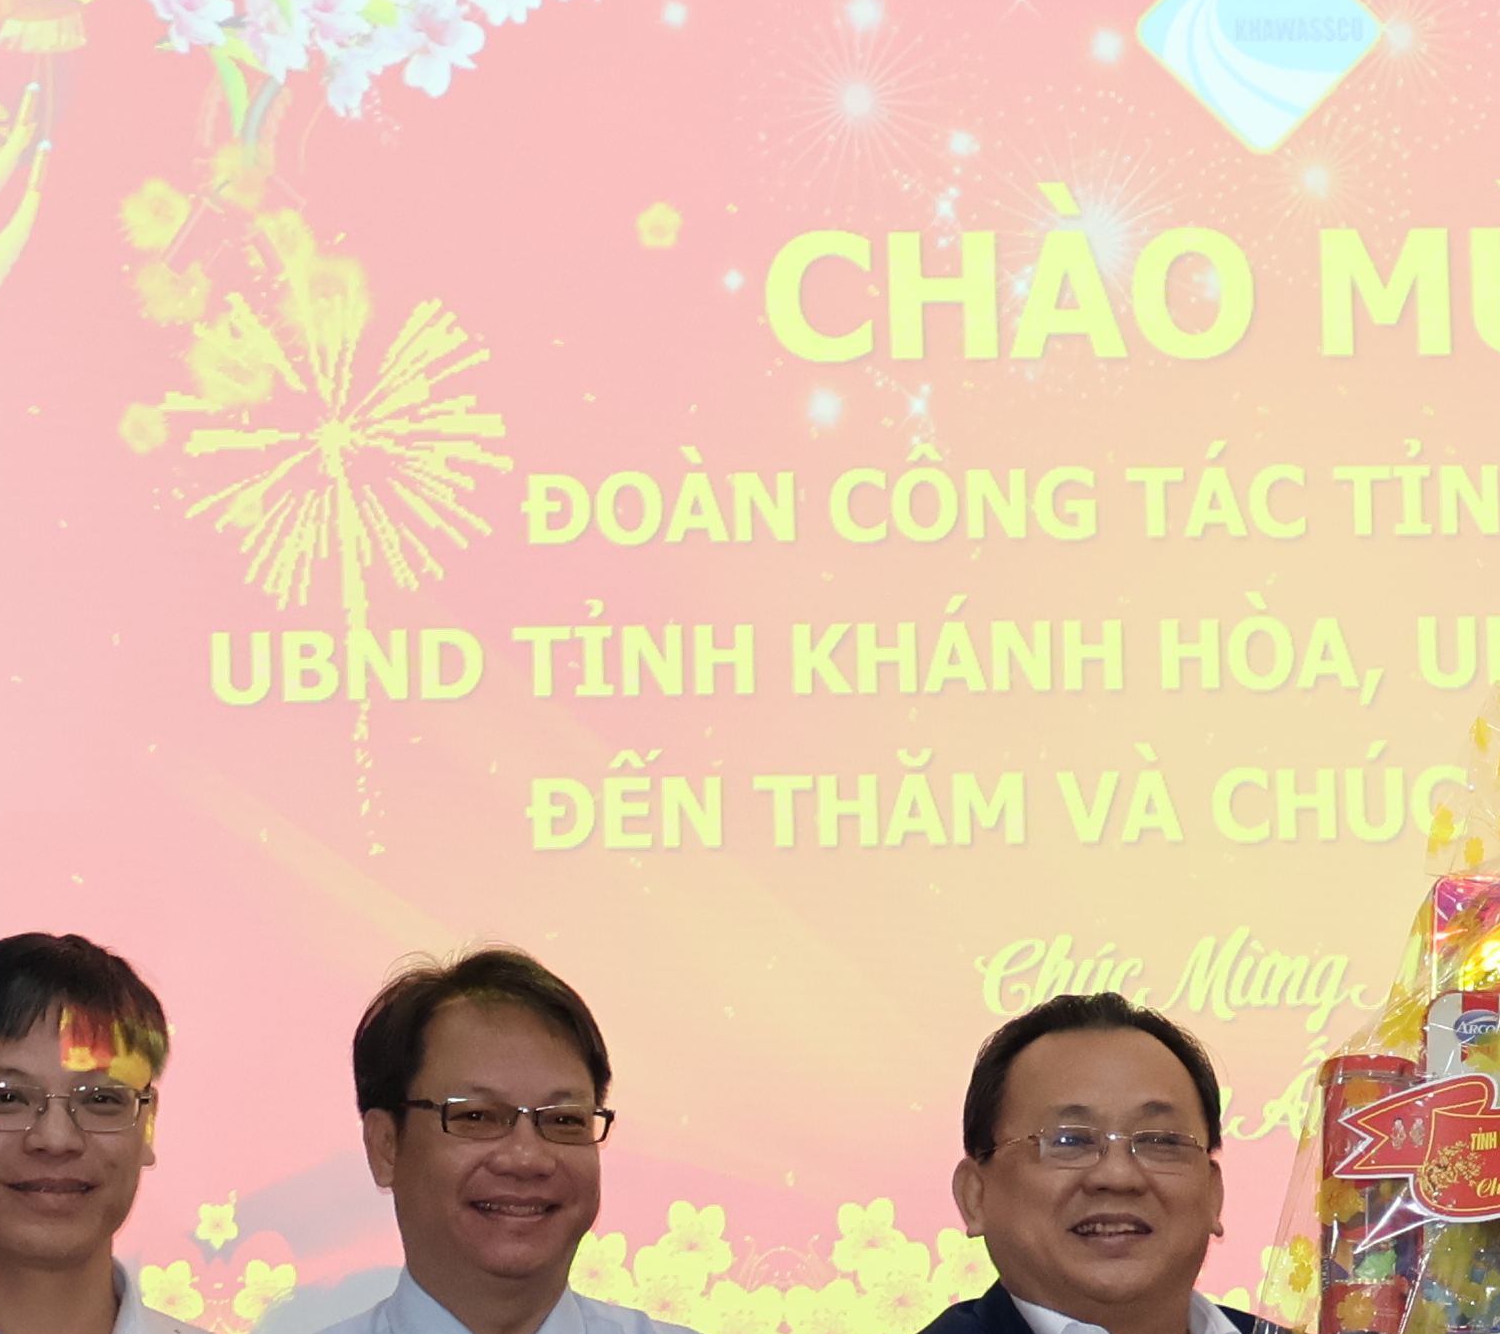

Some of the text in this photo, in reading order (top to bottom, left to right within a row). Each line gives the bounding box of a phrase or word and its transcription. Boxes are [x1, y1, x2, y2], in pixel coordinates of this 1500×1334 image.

[766, 182, 1254, 363] CHÀO
[522, 446, 796, 546] ĐOÀN
[830, 442, 1097, 543] CÔNG
[1125, 440, 1307, 539] TÁC
[210, 627, 484, 706] UBND
[512, 599, 755, 697] TỈNH
[791, 594, 1124, 694] KHÁNH
[1158, 591, 1384, 703] HÒA,
[526, 750, 722, 850] ĐẾN
[753, 748, 1026, 847] THĂM
[1056, 743, 1184, 843] VÀ
[1211, 739, 1468, 845] CHÚC
